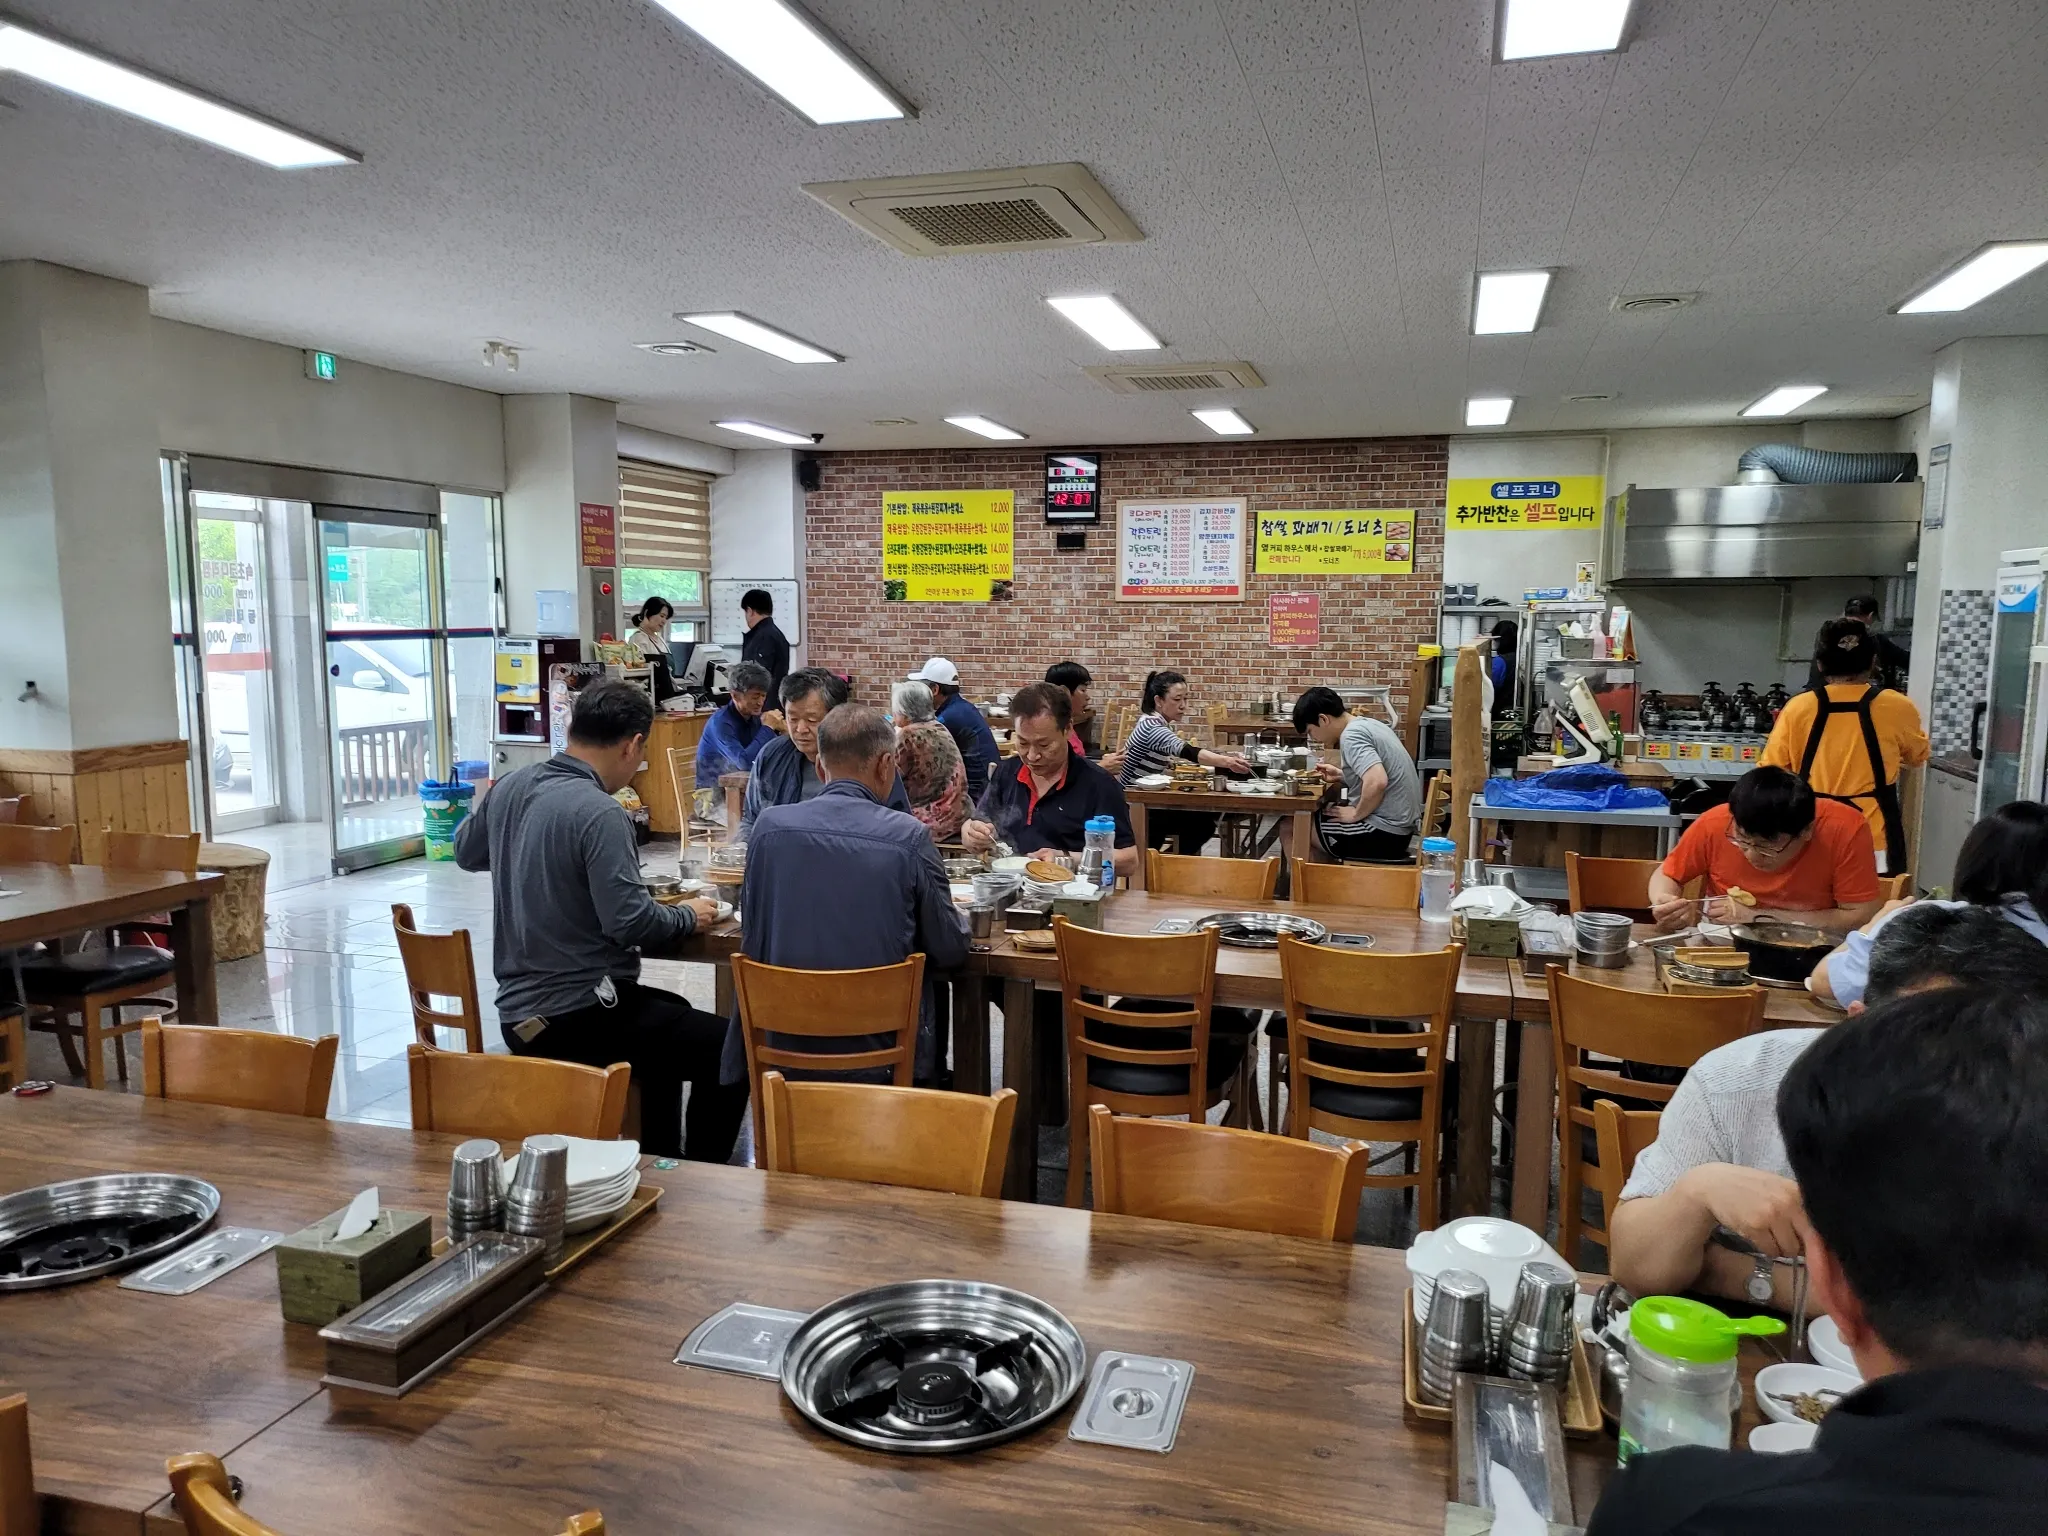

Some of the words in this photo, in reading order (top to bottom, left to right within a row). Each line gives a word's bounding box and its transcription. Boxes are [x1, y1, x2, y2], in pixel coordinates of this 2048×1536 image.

[1496, 484, 1556, 497] 셀프코너
[990, 502, 1010, 514] 12,000
[1456, 506, 1520, 523] 추가반찬은
[1524, 503, 1595, 522] 셀프입니다
[990, 523, 1010, 534] 14,000
[1261, 520, 1288, 536] 찹쌀
[990, 544, 1009, 554] 14,000
[1270, 544, 1283, 553] 커피
[991, 564, 1010, 574] 15,000
